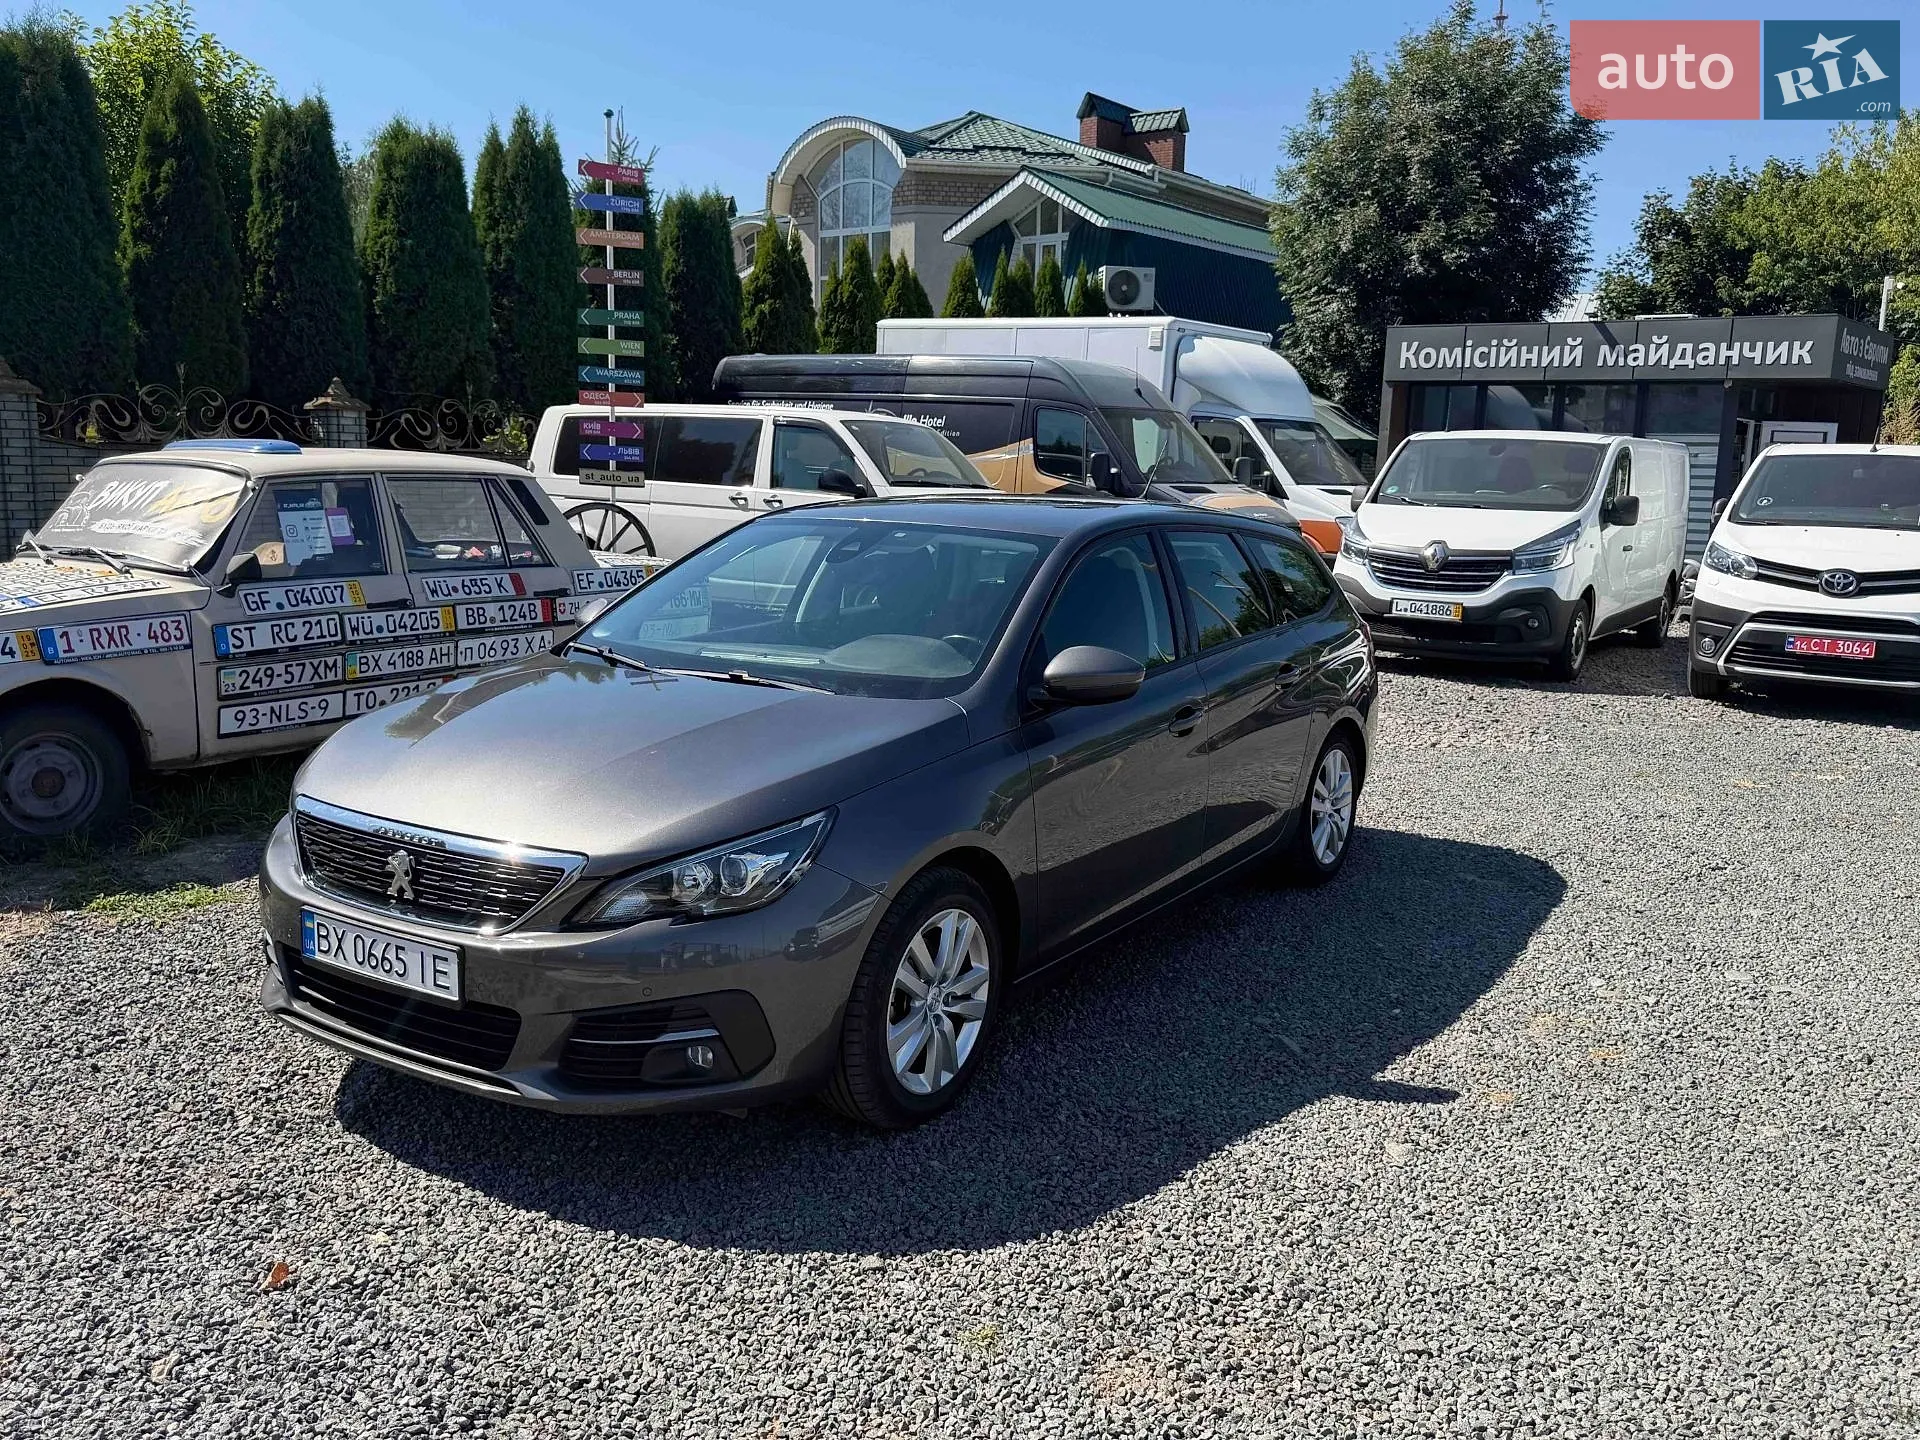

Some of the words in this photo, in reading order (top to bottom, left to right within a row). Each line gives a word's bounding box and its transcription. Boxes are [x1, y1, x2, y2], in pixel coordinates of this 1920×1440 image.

[617, 167, 639, 178] PARIS
[589, 230, 640, 241] AMSTERDAM
[613, 270, 640, 279] BERLIN
[614, 311, 641, 320] PRAHA
[620, 341, 641, 350] WIEN
[1399, 337, 1583, 369] Комісійний
[1597, 335, 1814, 369] майданчик
[595, 368, 641, 379] WARSZAWA
[582, 392, 611, 400] ОДЕСА
[583, 421, 601, 430] КИЇВ
[920, 414, 947, 428] Hotel
[618, 447, 640, 455] ЛЬВІВ
[585, 472, 640, 484] st_auto_ua
[88, 479, 174, 514] ВИКУП
[494, 576, 509, 594] K
[576, 572, 595, 590] EF
[603, 569, 645, 588] 04365
[243, 590, 271, 612] GF
[284, 584, 345, 608] 04007
[465, 606, 488, 626] BB
[1395, 601, 1402, 613] L
[1409, 602, 1452, 616] 041886
[385, 610, 440, 634] 04205
[230, 626, 256, 650] ST
[271, 622, 298, 644] RC
[303, 617, 339, 642] 210
[477, 637, 519, 660] 0693
[1795, 640, 1808, 651] 14
[1810, 638, 1832, 652] CT
[1835, 640, 1870, 655] 3064
[358, 653, 383, 674] BX
[387, 650, 424, 670] 4188
[428, 645, 451, 666] AH
[224, 683, 237, 693] 23
[353, 690, 377, 712] TO
[234, 698, 330, 729] 93-NLS-9
[379, 826, 439, 846] PEUGEOT
[305, 939, 315, 951] UA
[316, 921, 347, 961] BX
[353, 933, 407, 978] 0665
[420, 950, 451, 990] IE
